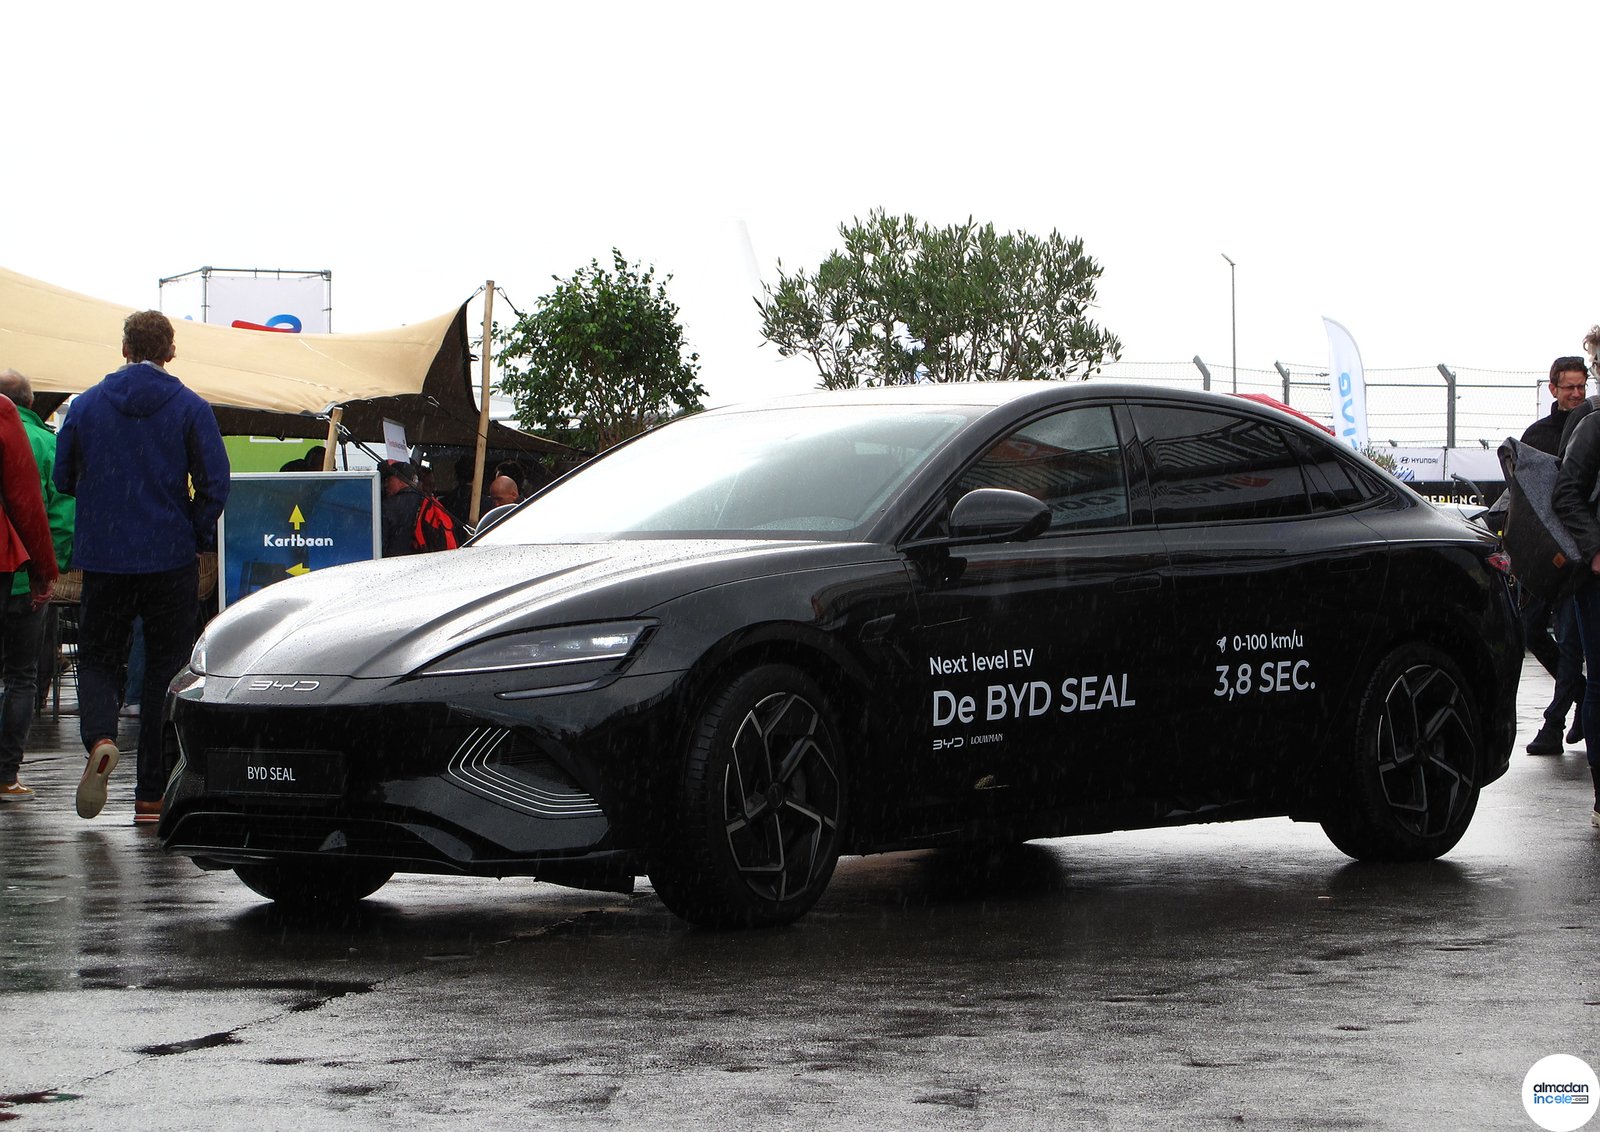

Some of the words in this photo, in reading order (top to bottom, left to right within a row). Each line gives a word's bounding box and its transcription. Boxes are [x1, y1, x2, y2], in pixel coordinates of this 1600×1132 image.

[263, 533, 334, 547] Kartbaan
[1233, 633, 1268, 651] 0-100
[1270, 629, 1304, 650] km/u
[929, 655, 969, 676] Next
[971, 650, 1009, 672] level
[1013, 648, 1034, 668] EV
[248, 680, 320, 691] BYD
[1213, 663, 1253, 702] 3,8
[1259, 659, 1316, 693] SEC.
[932, 690, 976, 727] De
[986, 681, 1052, 721] BYD
[1060, 673, 1136, 713] SEAL
[932, 736, 964, 750] BYD
[970, 733, 1004, 745] LOUWMAN
[247, 766, 268, 780] BYD
[269, 767, 296, 781] SEAL
